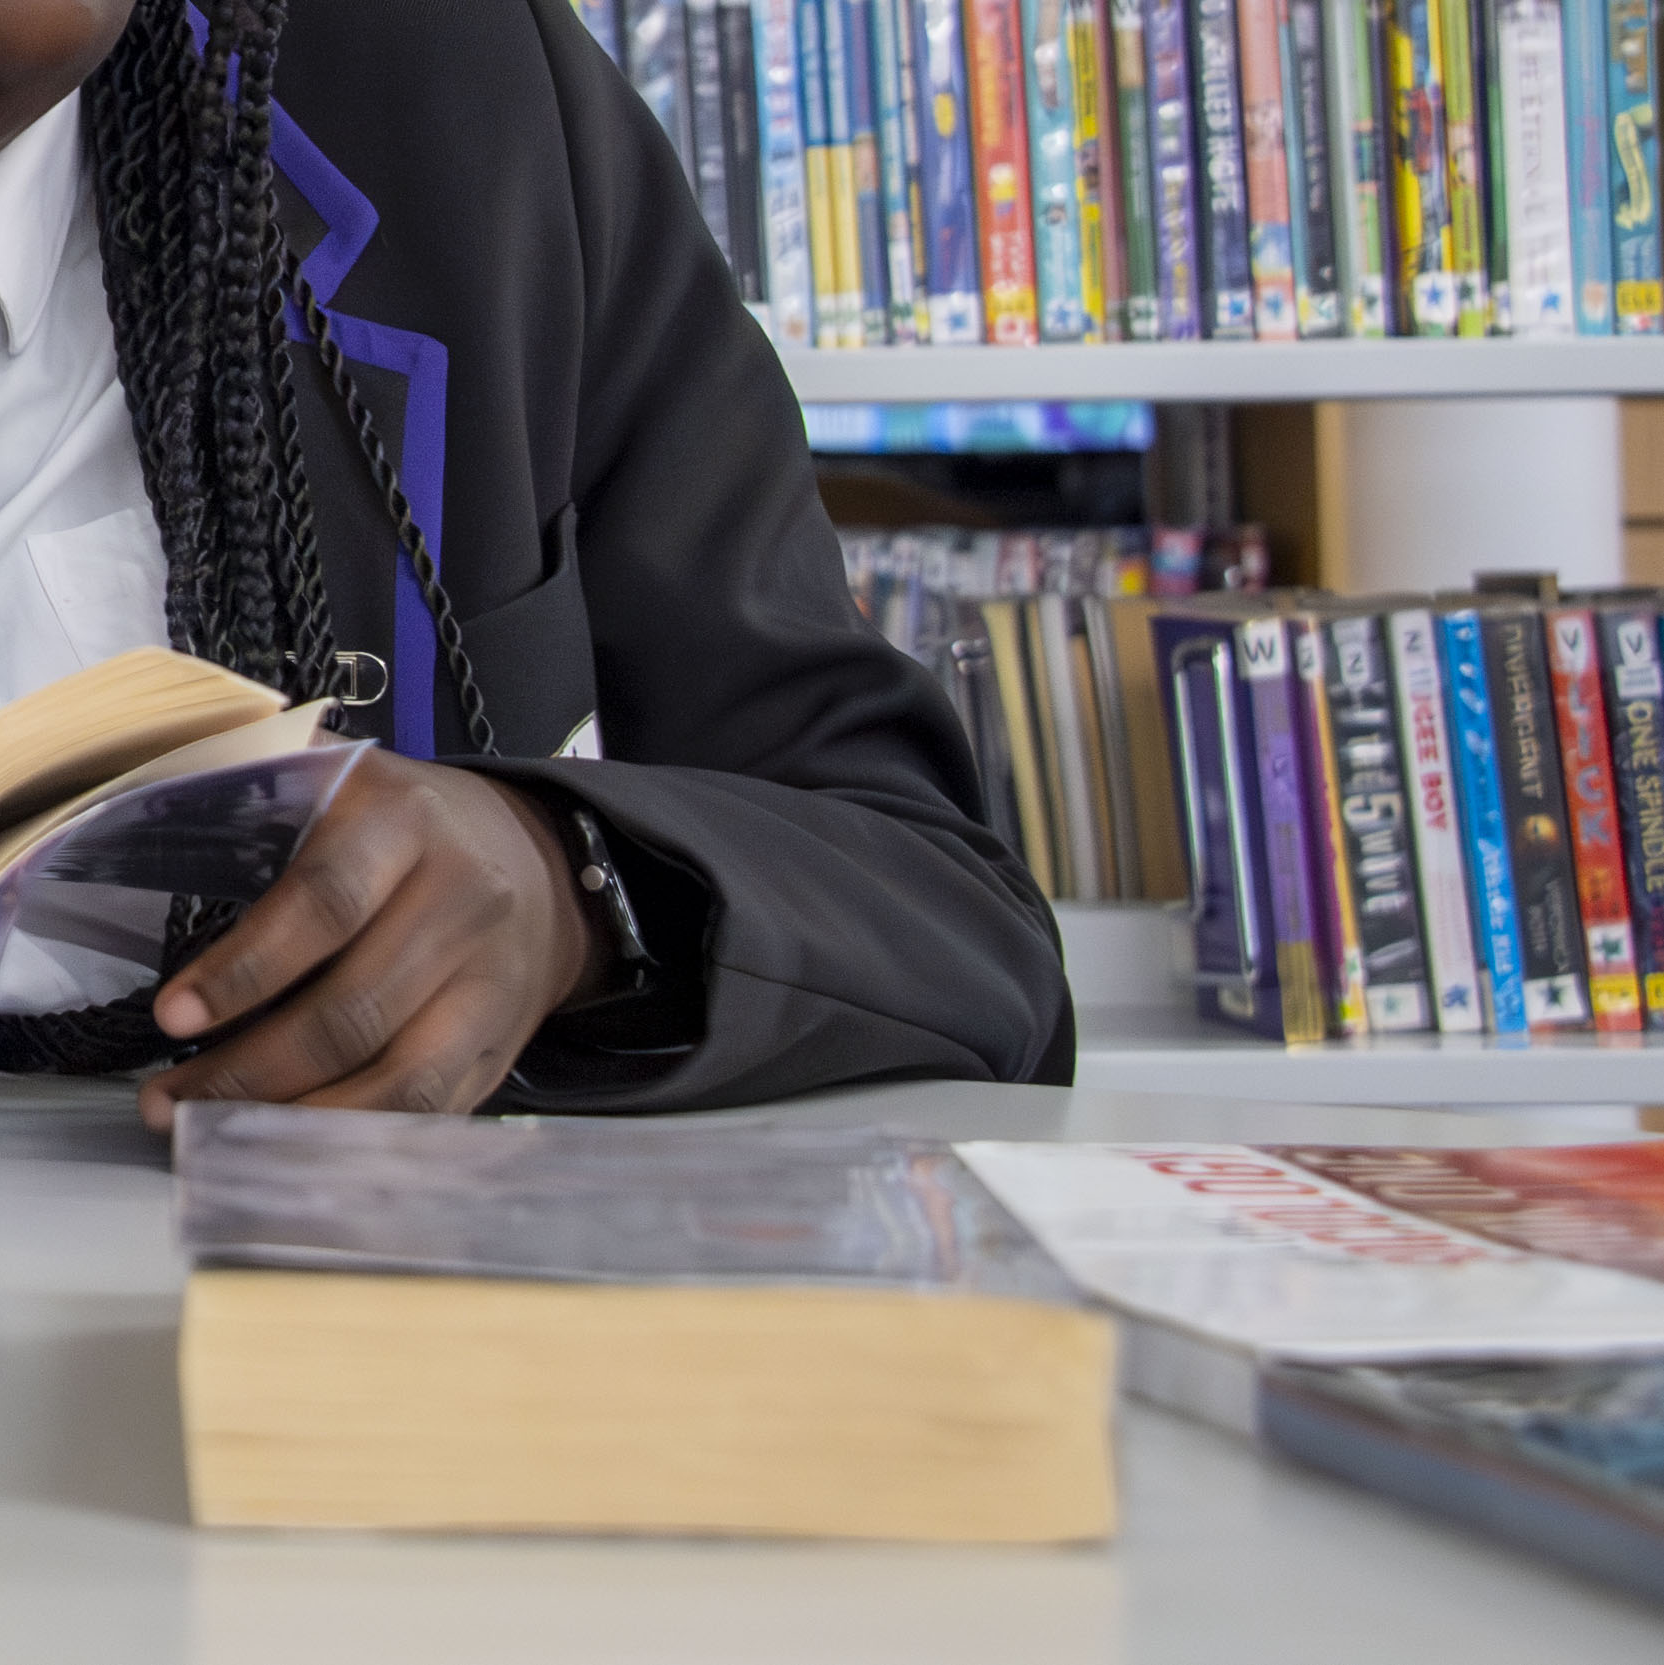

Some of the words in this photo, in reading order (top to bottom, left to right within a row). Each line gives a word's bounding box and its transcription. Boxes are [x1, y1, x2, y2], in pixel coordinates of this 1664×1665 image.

[1243, 636, 1276, 663] W
[1502, 622, 1543, 799] DIVERGENT
[1625, 700, 1659, 768] ONE
[1342, 791, 1402, 830] 5
[1420, 771, 1448, 833] BOY
[1633, 773, 1664, 894] SPINDLE
[1127, 1151, 1489, 1266] SOCIOLOGY
